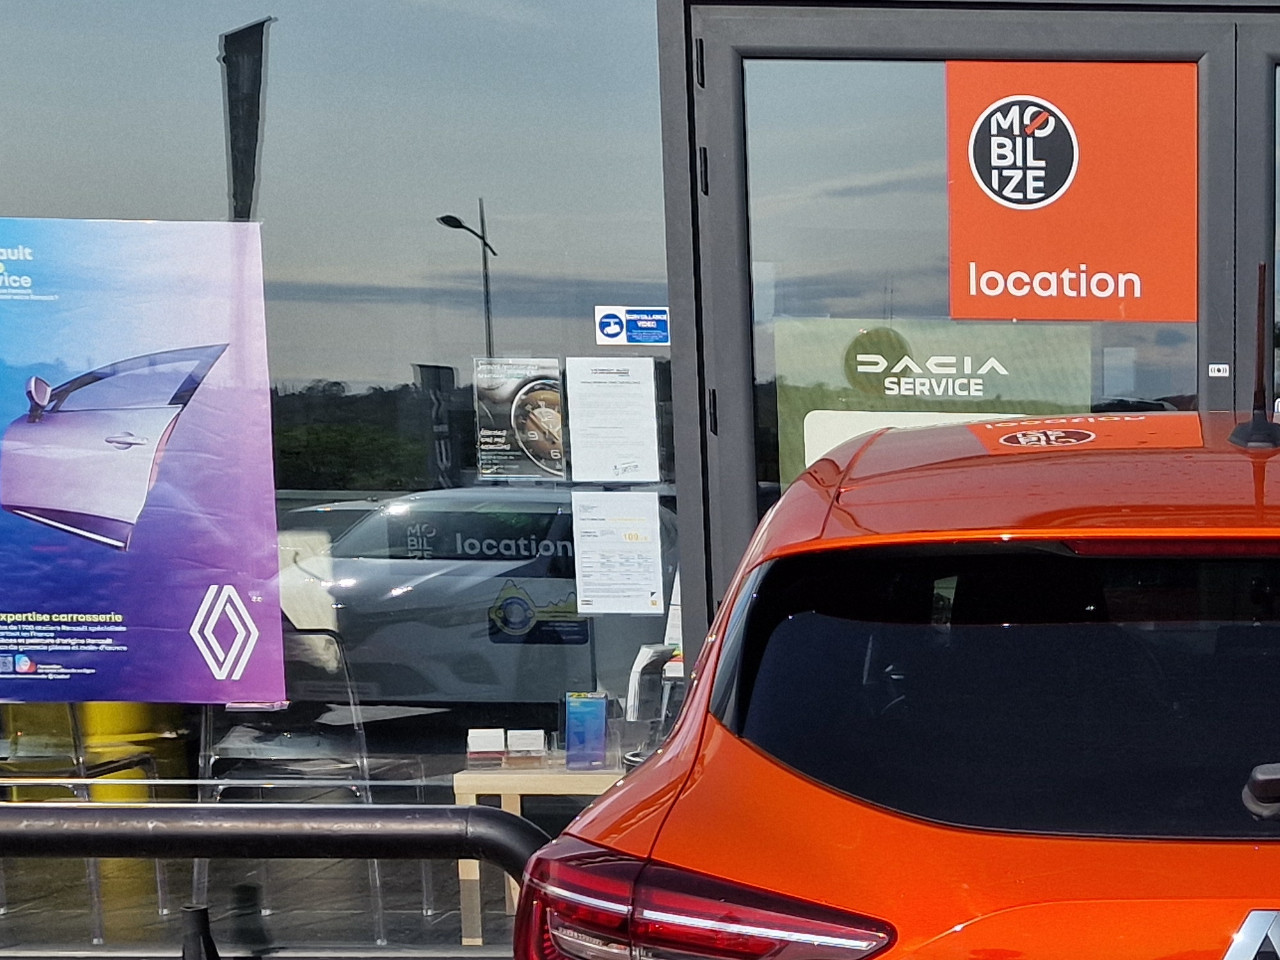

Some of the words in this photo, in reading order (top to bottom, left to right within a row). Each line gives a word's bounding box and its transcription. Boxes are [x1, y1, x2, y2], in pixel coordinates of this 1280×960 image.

[968, 261, 1142, 298] location
[856, 354, 1010, 375] DACIA
[883, 376, 984, 397] SERVICE
[455, 532, 573, 557] location
[51, 612, 123, 623] carrosserie
